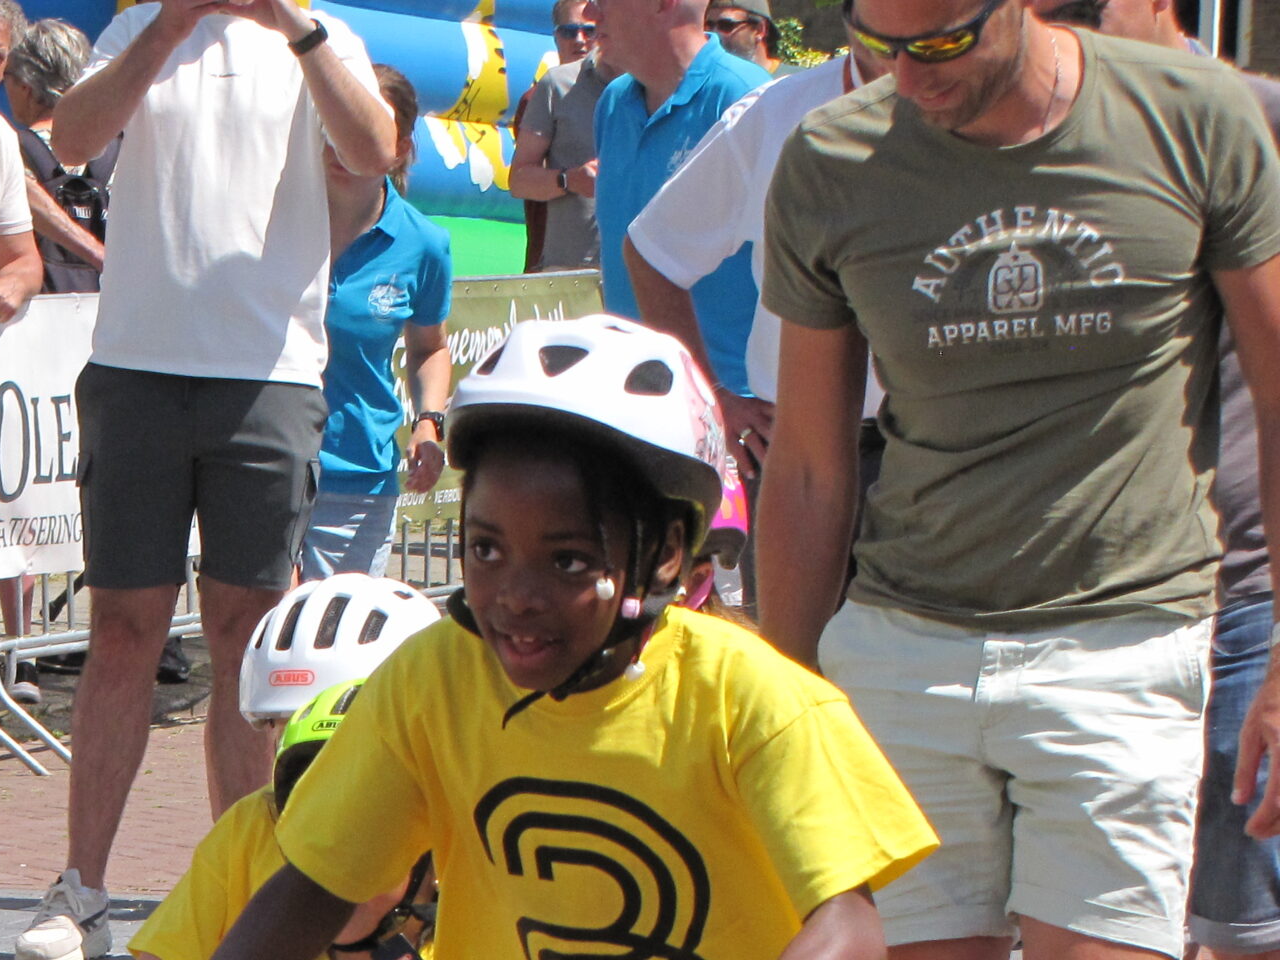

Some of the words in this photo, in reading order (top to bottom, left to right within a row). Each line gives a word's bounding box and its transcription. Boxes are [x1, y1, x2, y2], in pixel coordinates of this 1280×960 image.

[912, 206, 1125, 303] AUTHENTIC
[927, 317, 1044, 348] APPAREL
[1054, 311, 1112, 336] MFG
[274, 672, 309, 683] ABUS
